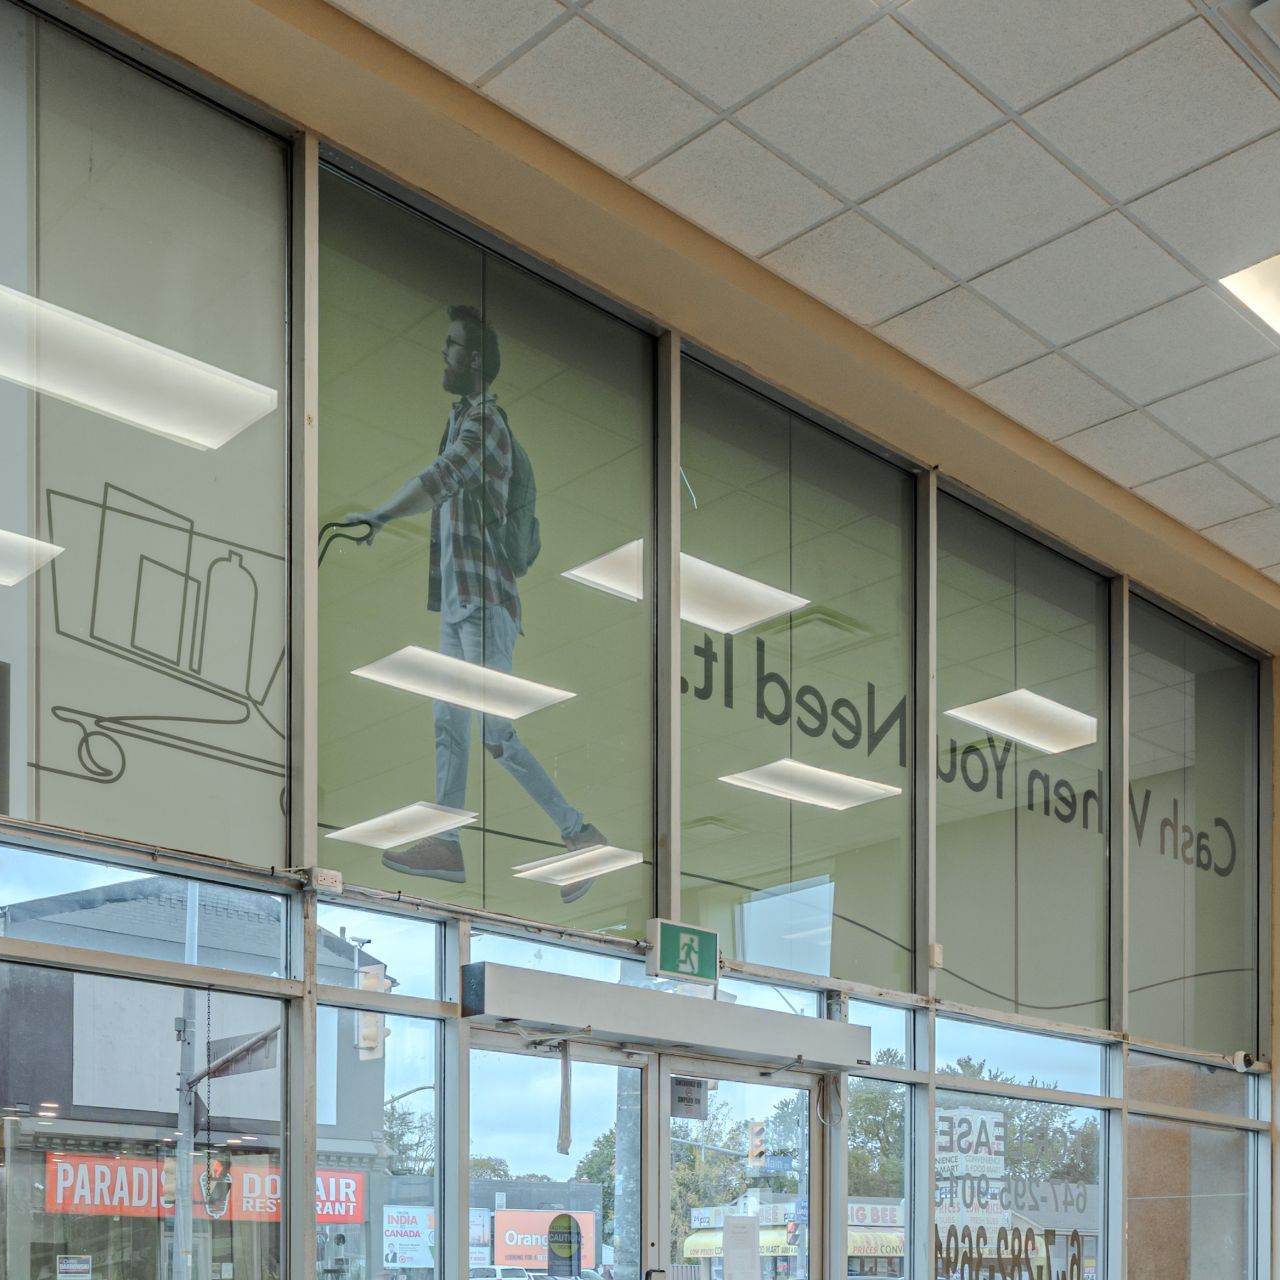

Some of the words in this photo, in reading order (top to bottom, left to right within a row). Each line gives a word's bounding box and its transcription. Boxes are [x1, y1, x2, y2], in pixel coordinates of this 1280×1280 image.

[56, 1162, 176, 1209] PARADI
[242, 1172, 357, 1203] DOAIR
[242, 1198, 357, 1216] RESRANT
[871, 1206, 897, 1224] BEE
[387, 1215, 419, 1226] INDIA
[384, 1229, 422, 1239] CANADA
[549, 1232, 582, 1242] CAUTION
